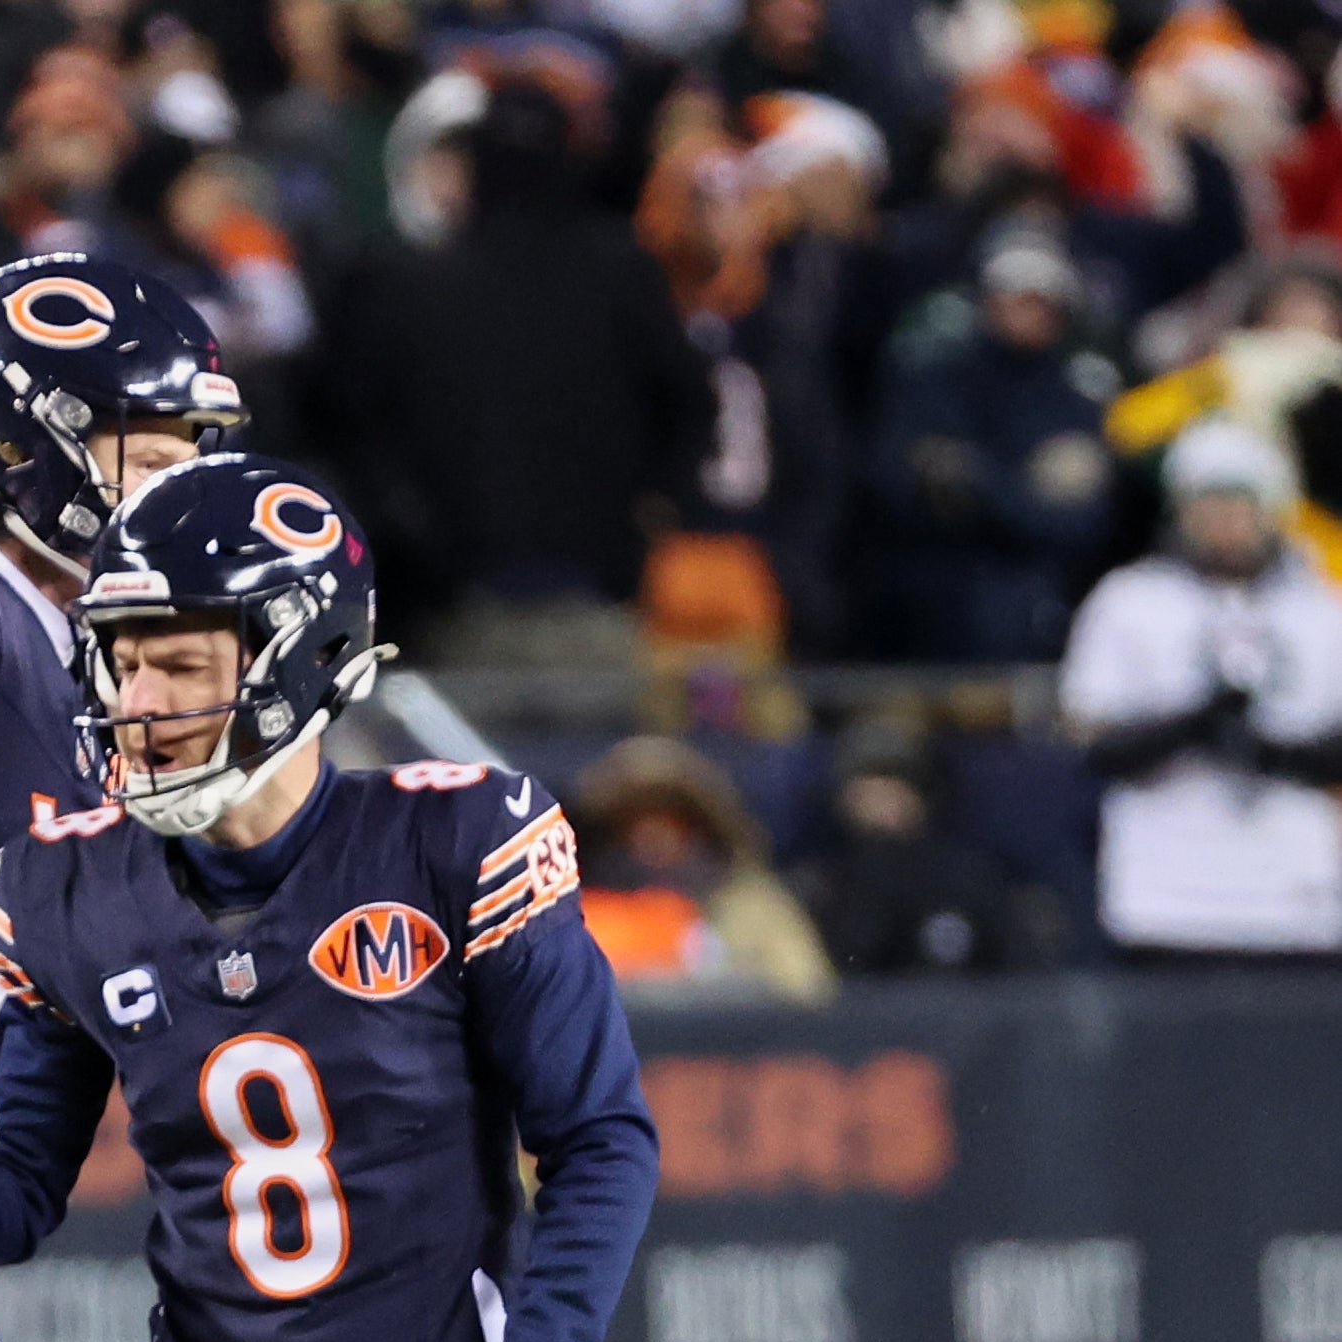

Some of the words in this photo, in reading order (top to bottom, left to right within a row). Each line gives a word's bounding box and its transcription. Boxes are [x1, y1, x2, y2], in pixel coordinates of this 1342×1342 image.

[3, 276, 115, 349] C
[251, 483, 343, 554] C
[103, 969, 154, 1025] C
[199, 1031, 350, 1300] 8
